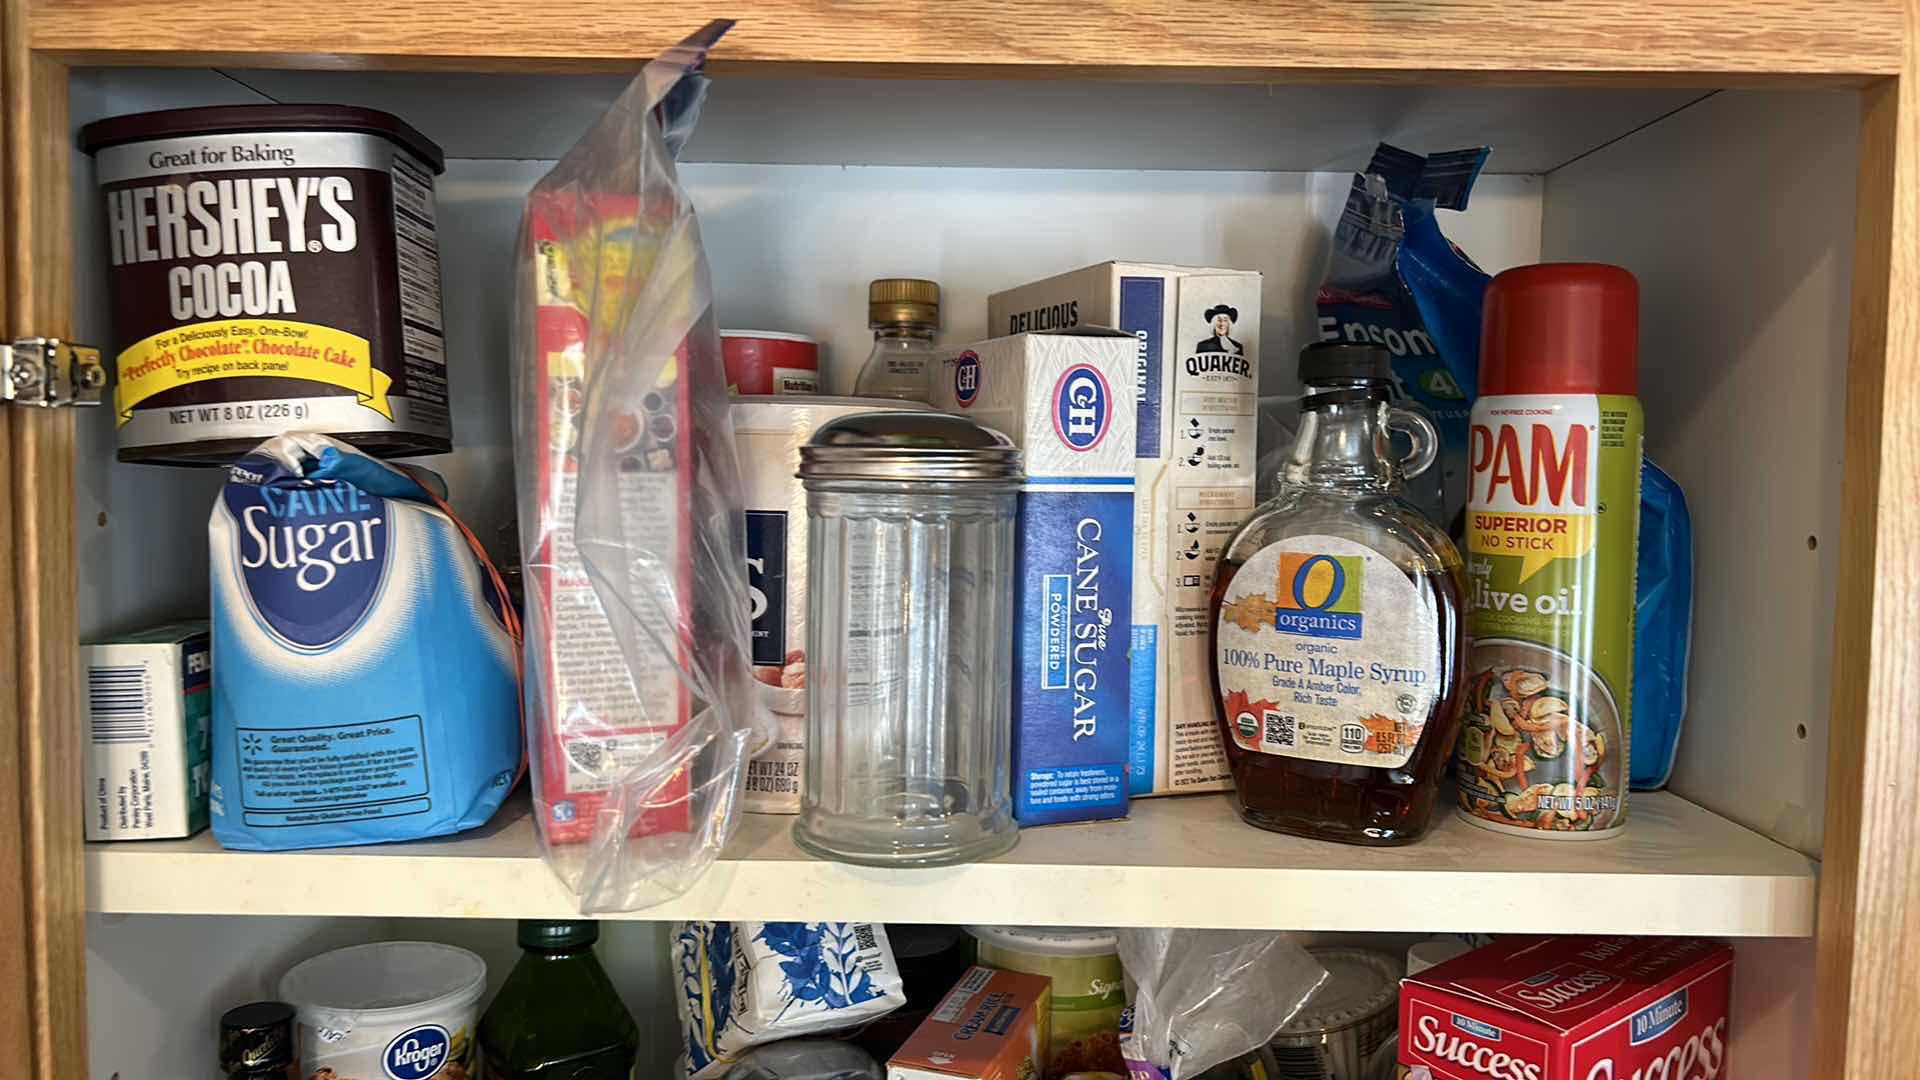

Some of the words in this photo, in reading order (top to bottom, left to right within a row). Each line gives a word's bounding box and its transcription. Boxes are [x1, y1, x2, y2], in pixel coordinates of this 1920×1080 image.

[149, 150, 195, 170] Great
[201, 147, 225, 164] for
[232, 144, 296, 167] Baking
[107, 176, 358, 266] HERSHEY'S
[168, 260, 297, 320] COCOA
[1009, 300, 1079, 335] DELICIOUS
[180, 326, 228, 345] Deliciously
[252, 340, 320, 359] Chocolate
[323, 347, 357, 368] Cake
[1185, 355, 1251, 379] QUAKER
[191, 362, 221, 378] recipe
[170, 409, 195, 424] NET
[199, 407, 221, 423] WT
[223, 406, 233, 420] 8
[236, 405, 255, 420] OZ
[259, 403, 290, 422] (226
[295, 402, 310, 421] g)
[1468, 423, 1589, 507] PAM
[1475, 515, 1567, 534] SUPERIOR
[242, 505, 382, 592] Sugar
[1481, 535, 1500, 549] NO
[1505, 536, 1553, 550] STICK
[1075, 517, 1102, 612] CANE
[1292, 554, 1346, 611] O
[1535, 585, 1583, 615] oil
[1049, 592, 1062, 671] POWDERED
[1097, 607, 1113, 652] Pure
[1279, 611, 1357, 632] organics
[1295, 643, 1338, 655] organic
[1072, 623, 1098, 742] SUGAR
[1223, 648, 1260, 669] 100%
[1264, 653, 1303, 673] Pure
[1308, 658, 1365, 682] Maple
[1369, 662, 1427, 688] Syrup
[1272, 675, 1296, 690] Grade
[1298, 679, 1305, 690] A
[1306, 680, 1335, 693] Amber
[1294, 691, 1314, 704] Rich
[1315, 694, 1339, 707] Taste
[271, 735, 296, 744] Great
[337, 729, 365, 741] Great
[1343, 727, 1362, 740] 110
[1635, 1017, 1649, 1037] 10
[1649, 997, 1684, 1031] Minute
[393, 1039, 447, 1072] Kroger
[1413, 1015, 1541, 1080] Success
